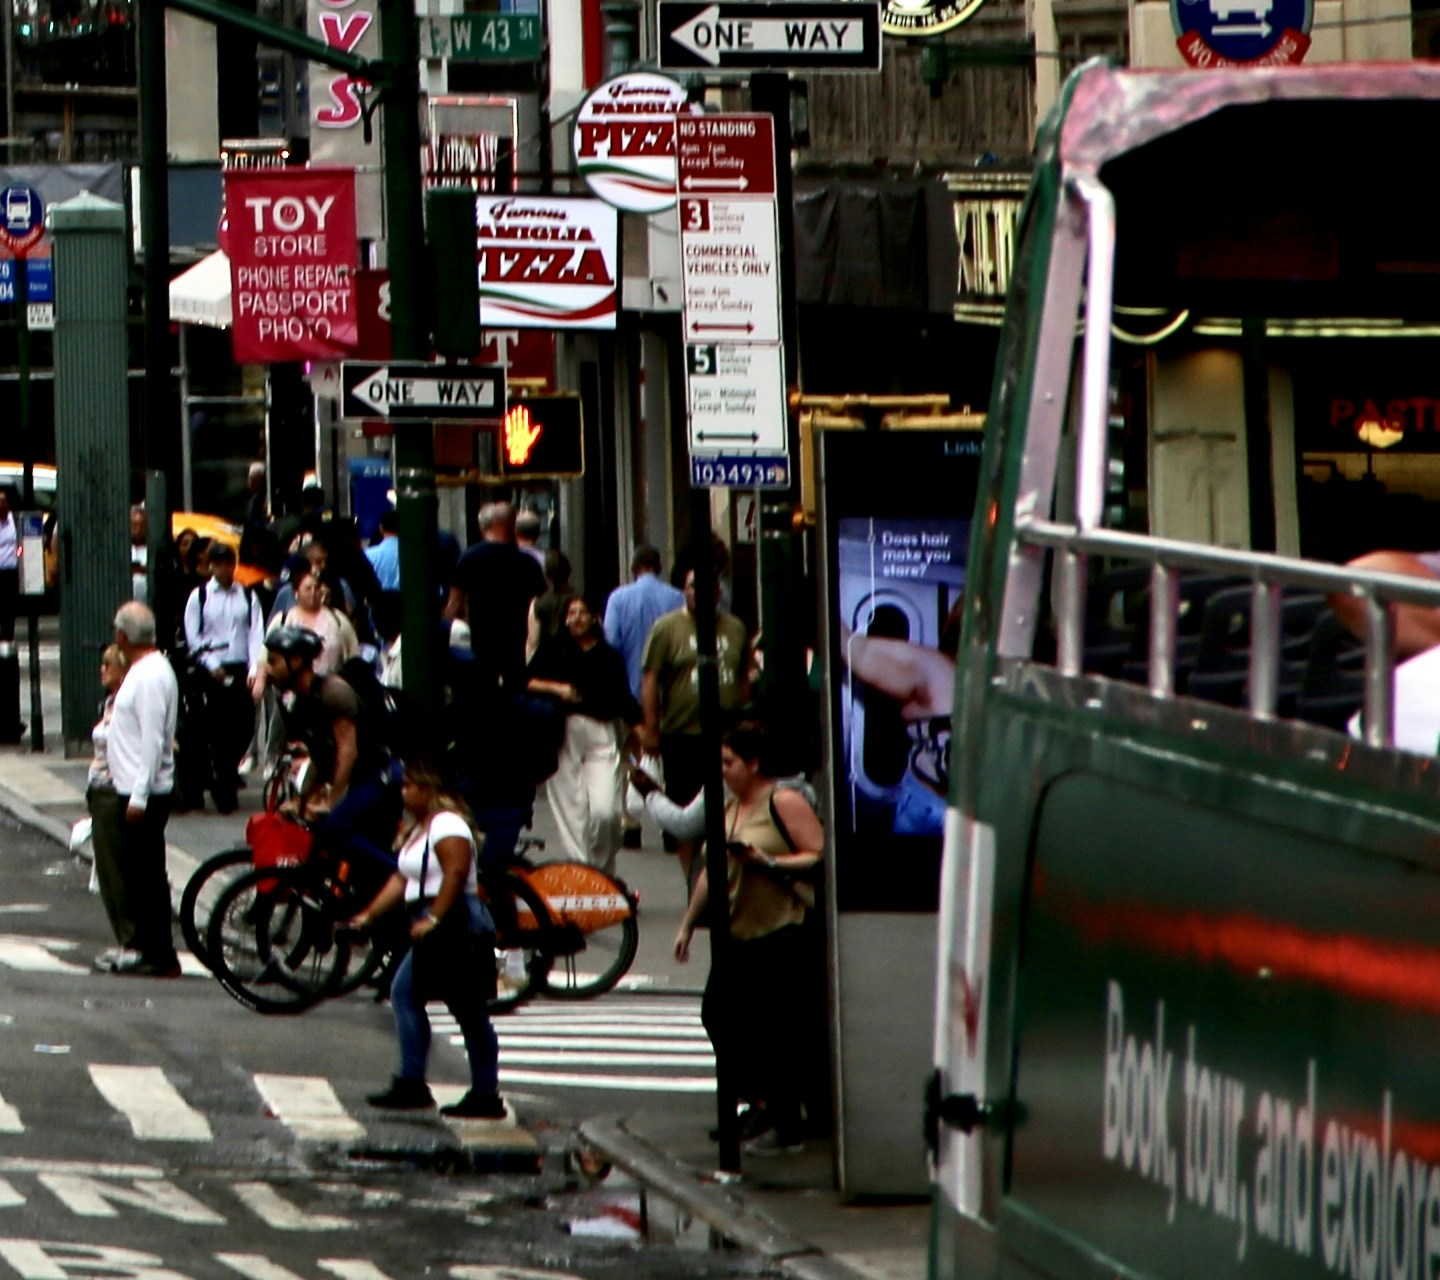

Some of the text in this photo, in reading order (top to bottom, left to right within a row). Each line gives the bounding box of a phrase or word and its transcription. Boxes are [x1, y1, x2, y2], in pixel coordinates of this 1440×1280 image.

[453, 20, 472, 52] W
[482, 19, 510, 53] 43
[693, 20, 849, 49] ONE WAY
[609, 81, 672, 97] Famous
[579, 122, 677, 156] PIZZ
[681, 122, 756, 138] NO STANDING
[681, 154, 745, 171] Except Sunday
[245, 196, 336, 232] TOY
[489, 202, 568, 222] Famous
[687, 200, 703, 230] 3
[477, 225, 595, 241] AMIGLIA
[254, 235, 327, 256] STORE
[686, 244, 757, 258] COMMERCIAL
[477, 247, 615, 285] IZZA
[688, 261, 771, 276] VEHICLES ONLY
[238, 264, 351, 289] PHONE REPAIR
[239, 290, 351, 316] PASSPORT
[689, 300, 753, 313] Except Sunday
[258, 318, 331, 342] PHOTO
[695, 345, 710, 374] 5
[693, 402, 756, 415] Except Sunday
[943, 439, 985, 457] Link
[695, 463, 765, 482] 103493
[882, 530, 951, 547] Does hair
[882, 547, 952, 565] make you
[882, 562, 928, 578] stare?
[1102, 979, 1177, 1225] Book,
[1184, 1022, 1247, 1263] tour,
[1255, 1058, 1317, 1258] and
